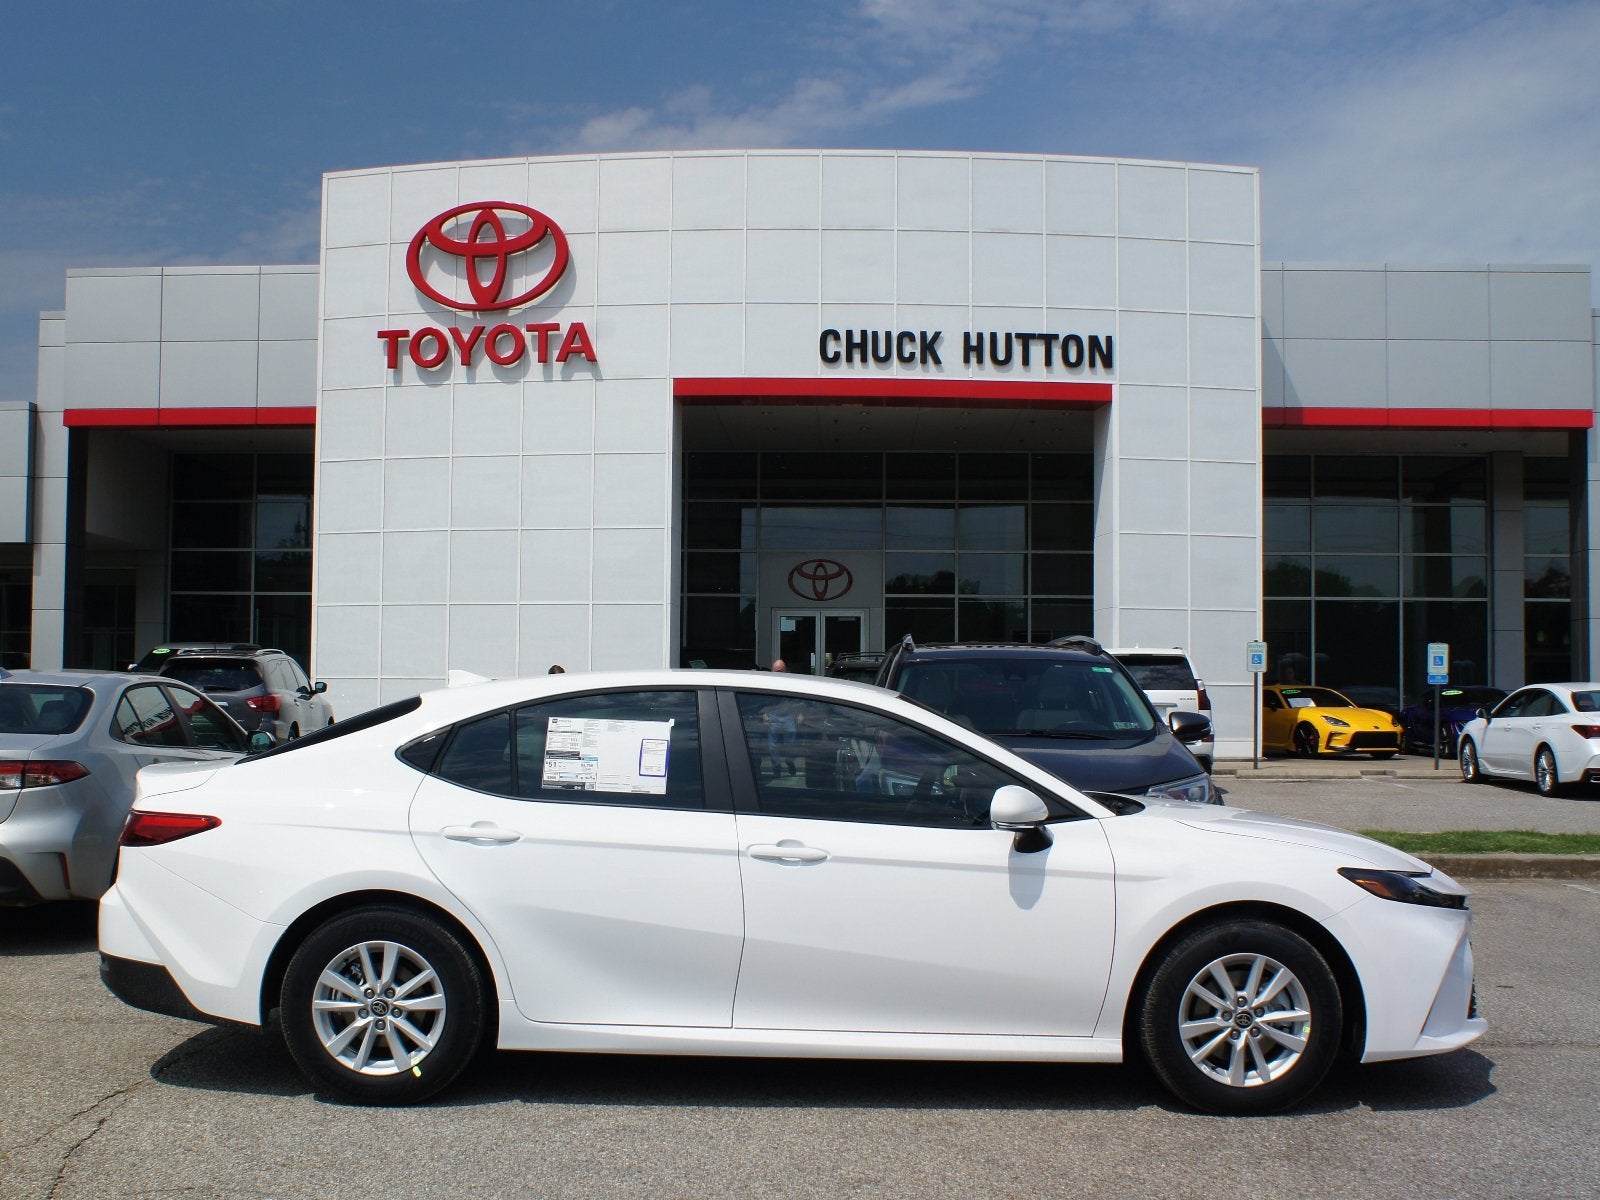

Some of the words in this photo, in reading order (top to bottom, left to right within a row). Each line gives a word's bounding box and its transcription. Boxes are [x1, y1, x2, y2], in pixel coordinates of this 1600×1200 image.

[377, 322, 598, 369] TOYOTA
[819, 328, 943, 365] CHUCK
[963, 331, 1113, 368] HUTTON
